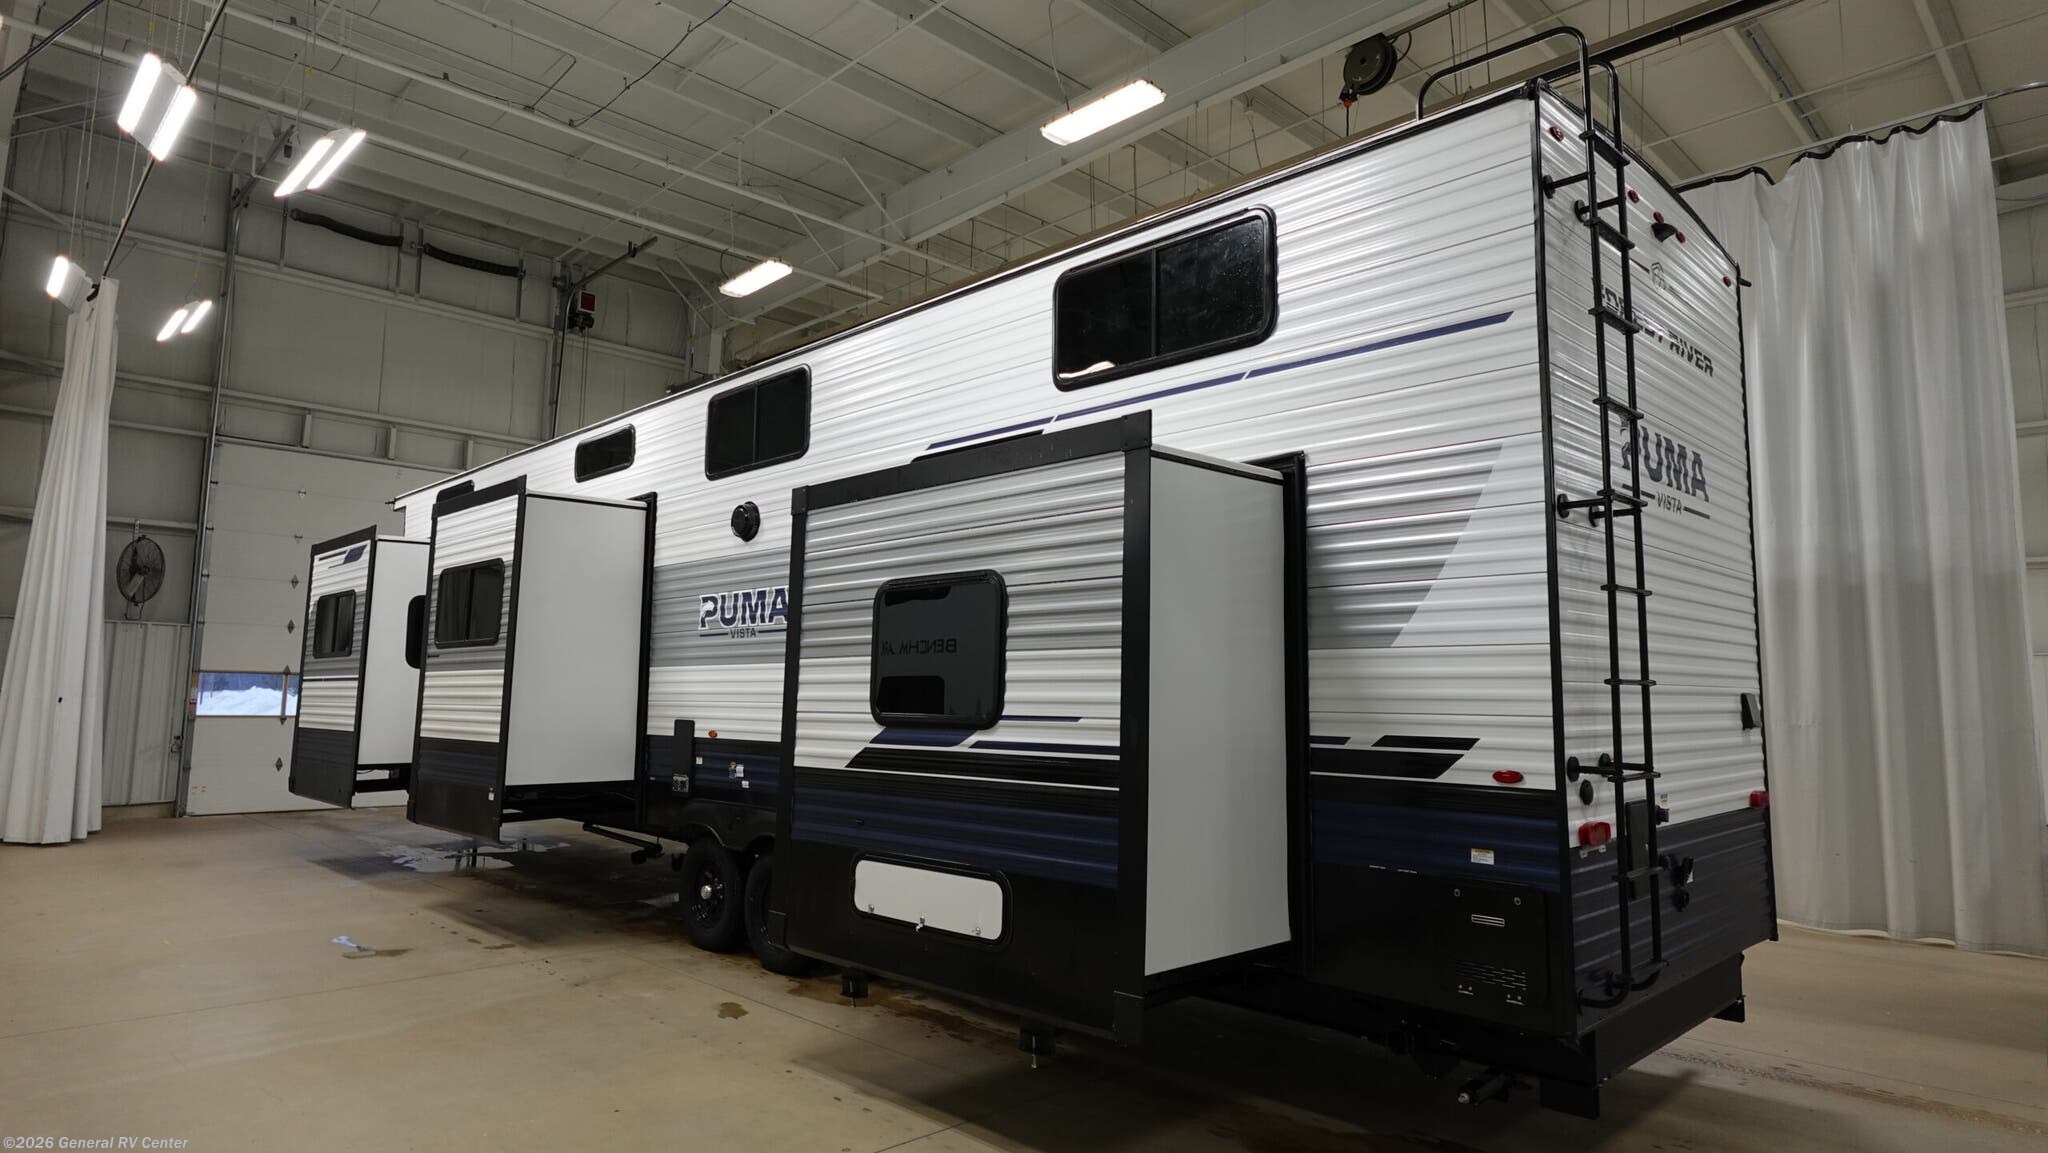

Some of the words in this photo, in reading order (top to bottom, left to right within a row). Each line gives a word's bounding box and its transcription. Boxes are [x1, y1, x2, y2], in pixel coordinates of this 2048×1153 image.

[1668, 329, 1714, 377] RIVER
[1656, 492, 1682, 515] VISTA
[698, 585, 789, 629] PUMA
[729, 628, 757, 639] VISTA
